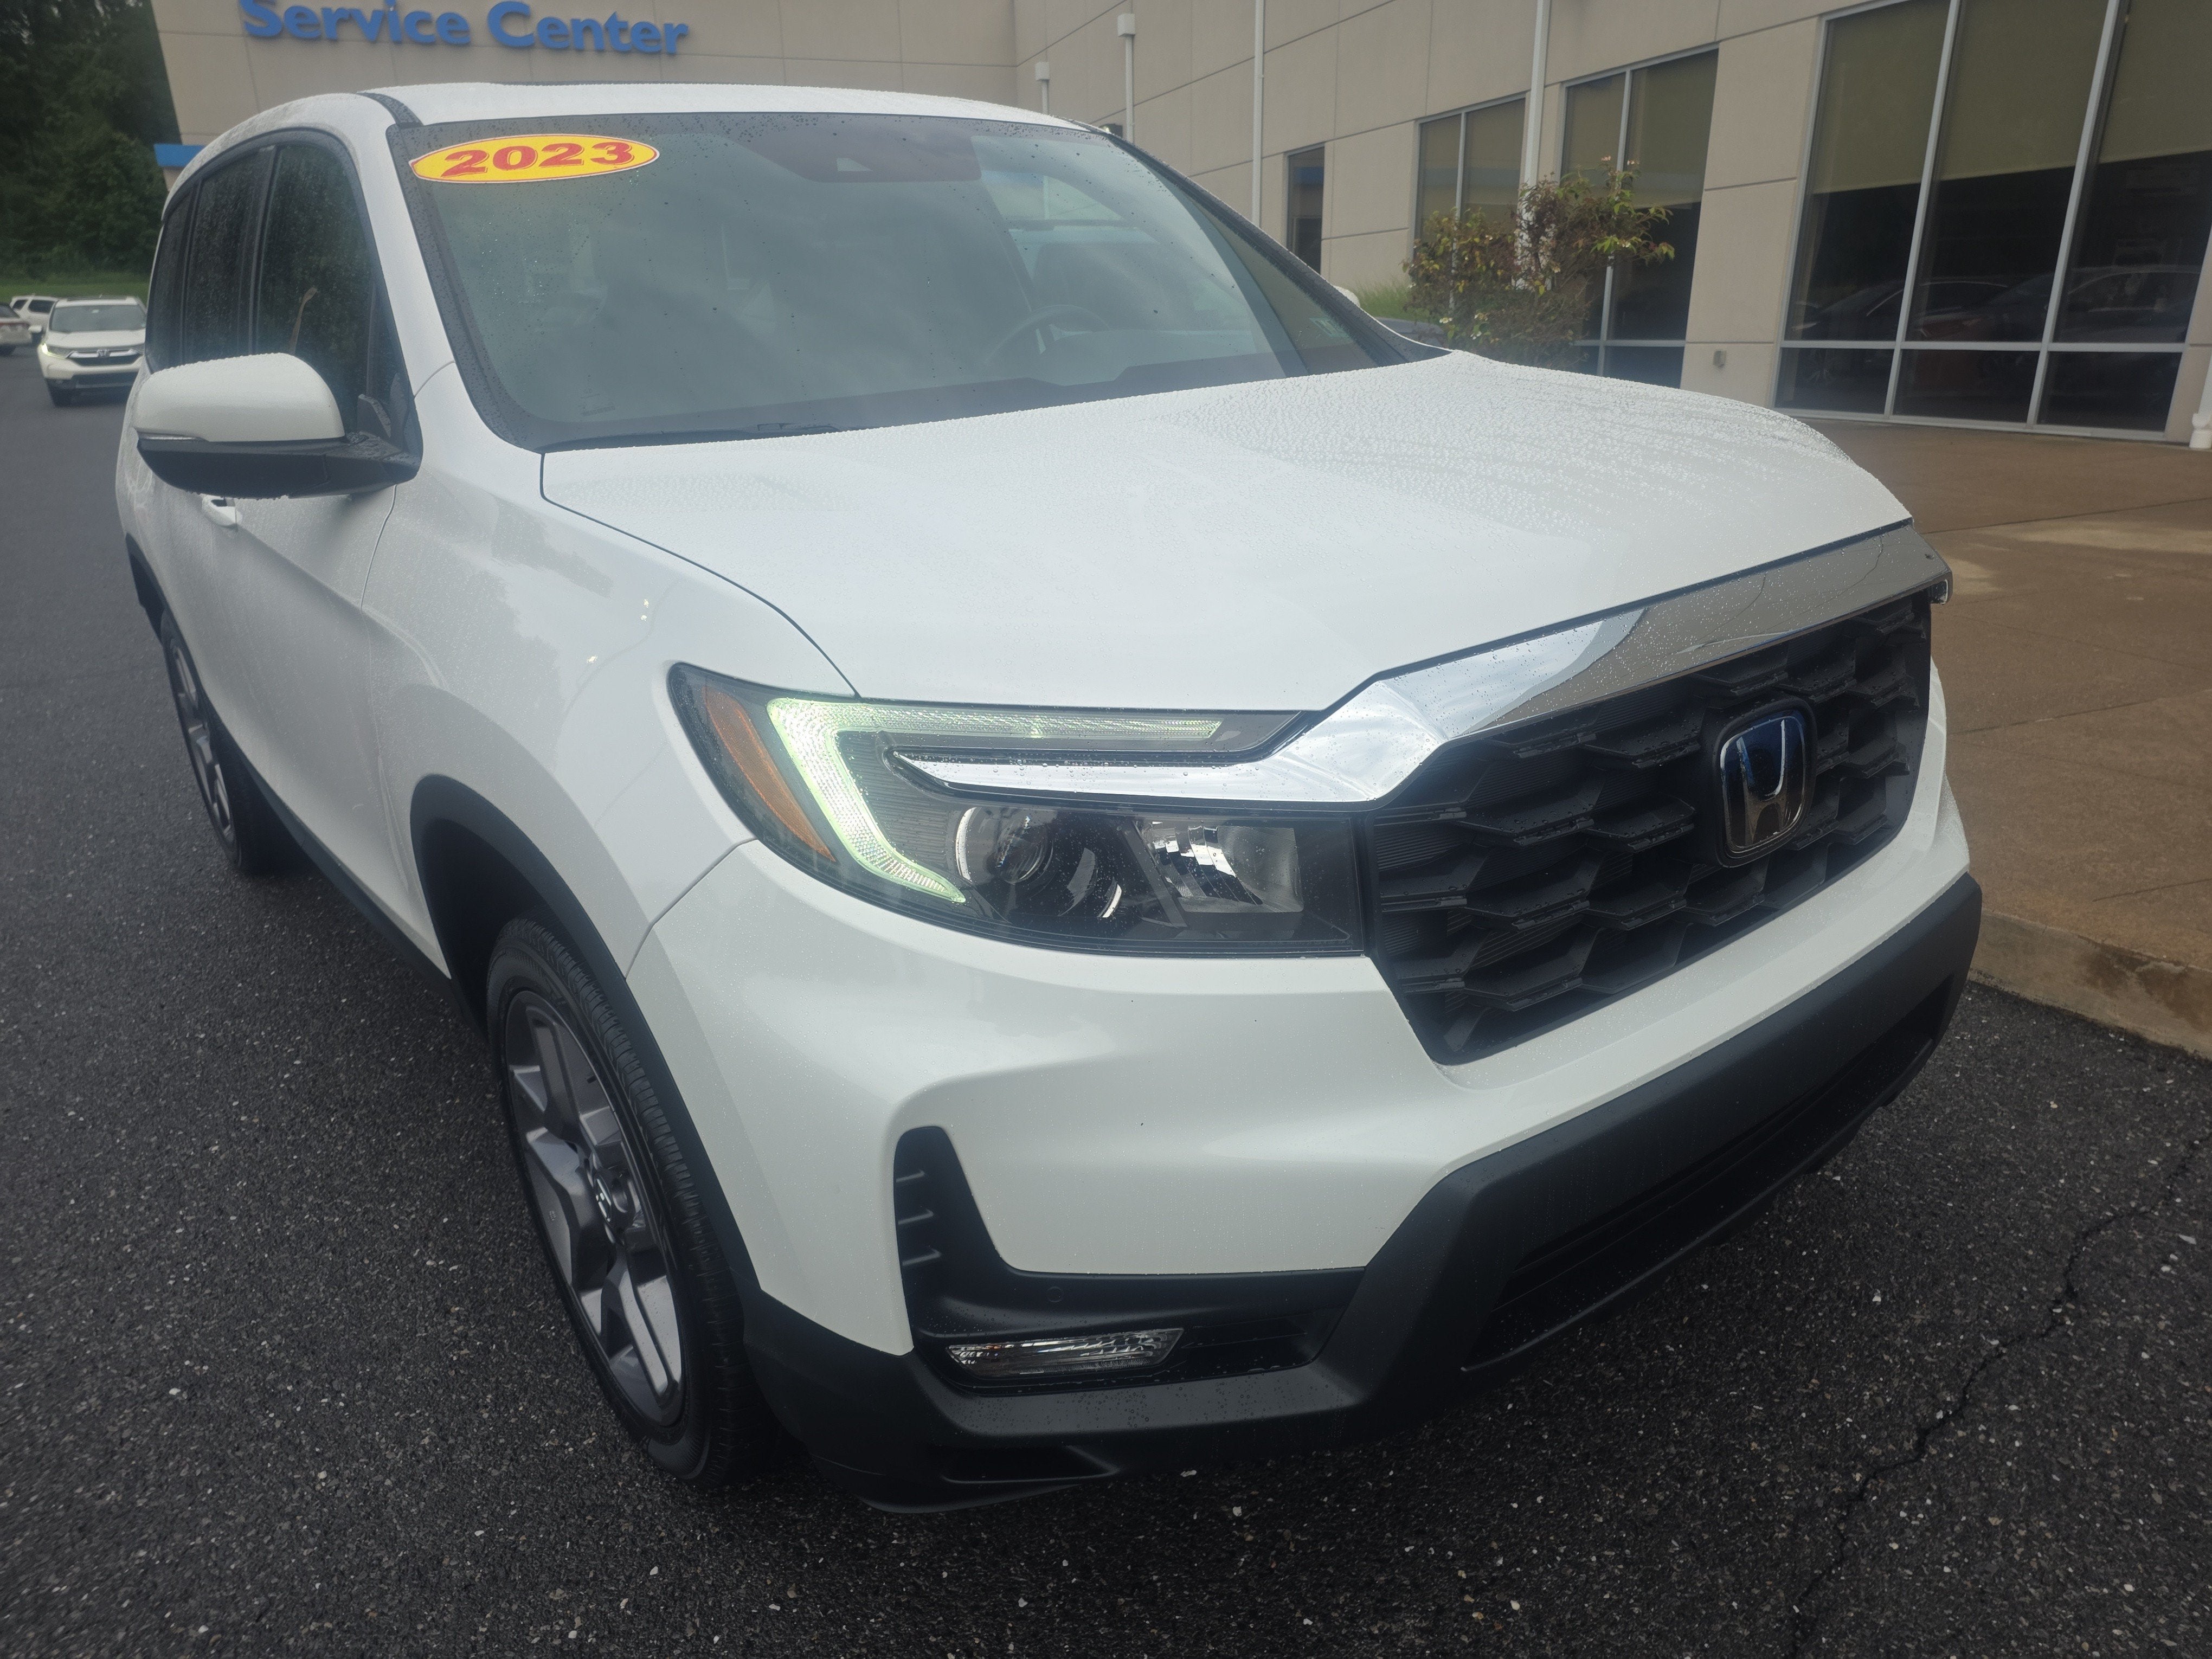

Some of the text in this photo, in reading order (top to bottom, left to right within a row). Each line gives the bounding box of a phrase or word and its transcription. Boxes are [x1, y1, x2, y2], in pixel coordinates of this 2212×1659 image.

[241, 0, 689, 54] Service Center
[440, 142, 635, 178] 2023
